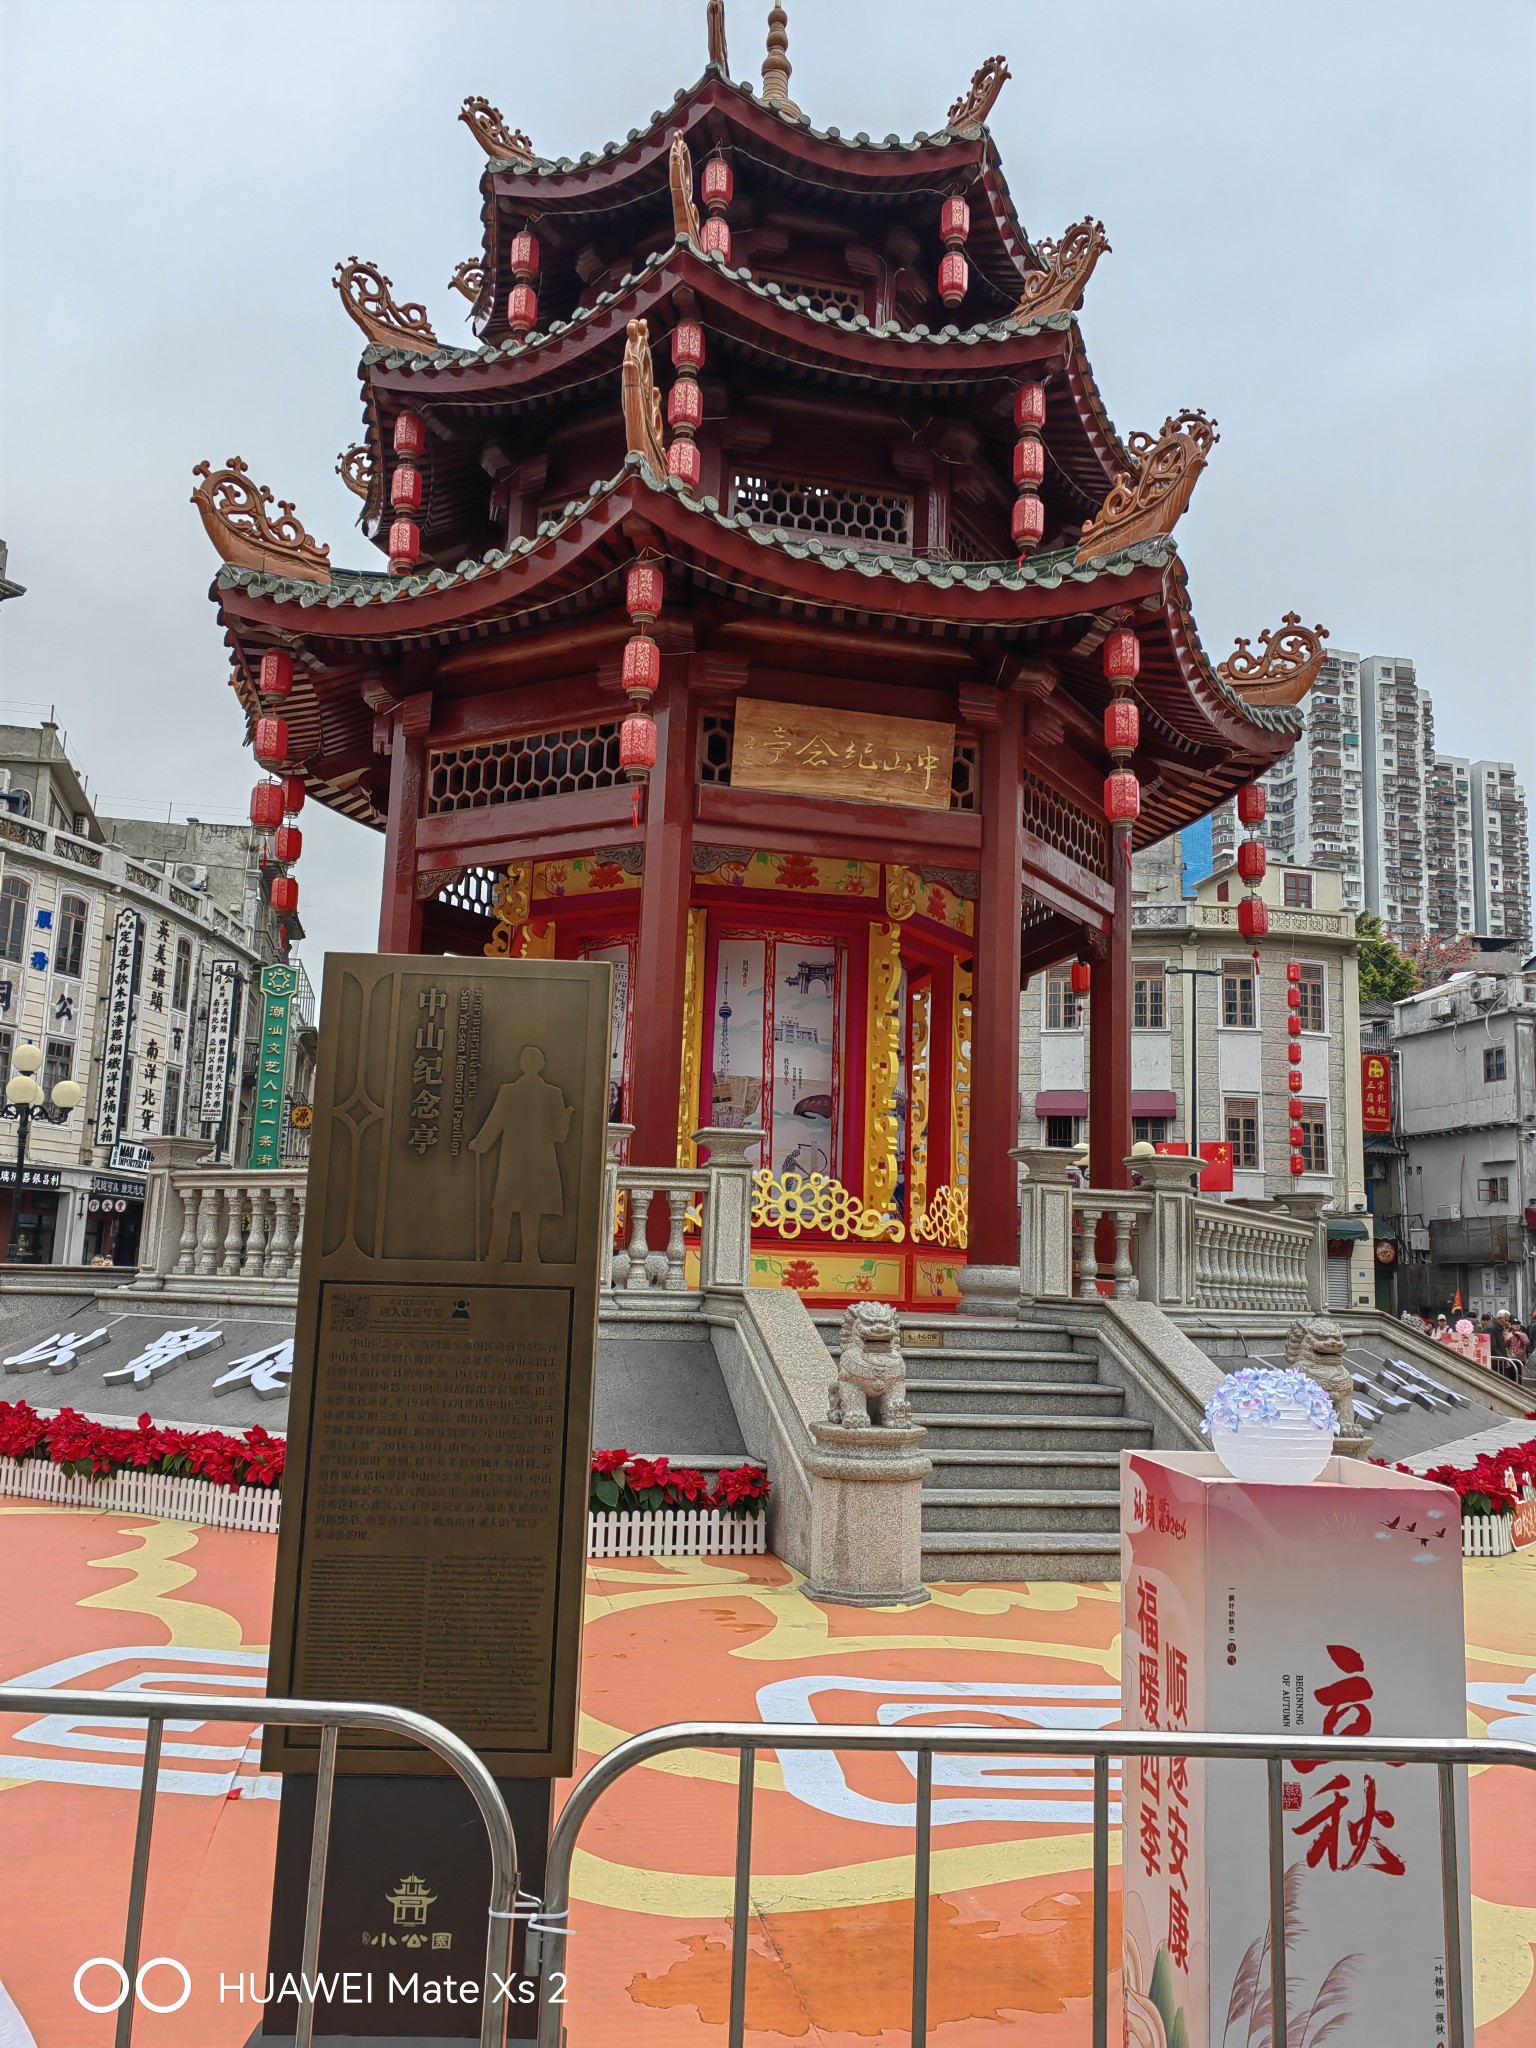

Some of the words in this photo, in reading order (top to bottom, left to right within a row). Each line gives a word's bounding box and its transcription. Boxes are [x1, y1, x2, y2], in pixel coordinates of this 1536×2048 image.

[460, 988, 472, 1010] Sun
[456, 1010, 471, 1052] Yat-sen
[141, 1038, 159, 1132] 南洋北貨
[256, 1005, 285, 1167] 潮汕文艺人才一条街
[408, 987, 448, 1155] 中山纪念亭
[453, 1054, 468, 1108] Memorial
[295, 1108, 310, 1125] 源
[450, 1110, 465, 1156] Pavilion
[1282, 1674, 1291, 1687] OF
[1295, 1675, 1304, 1726] BEGINNING
[1282, 1690, 1291, 1728] AUTUMN
[1291, 1645, 1406, 1876] 立秋
